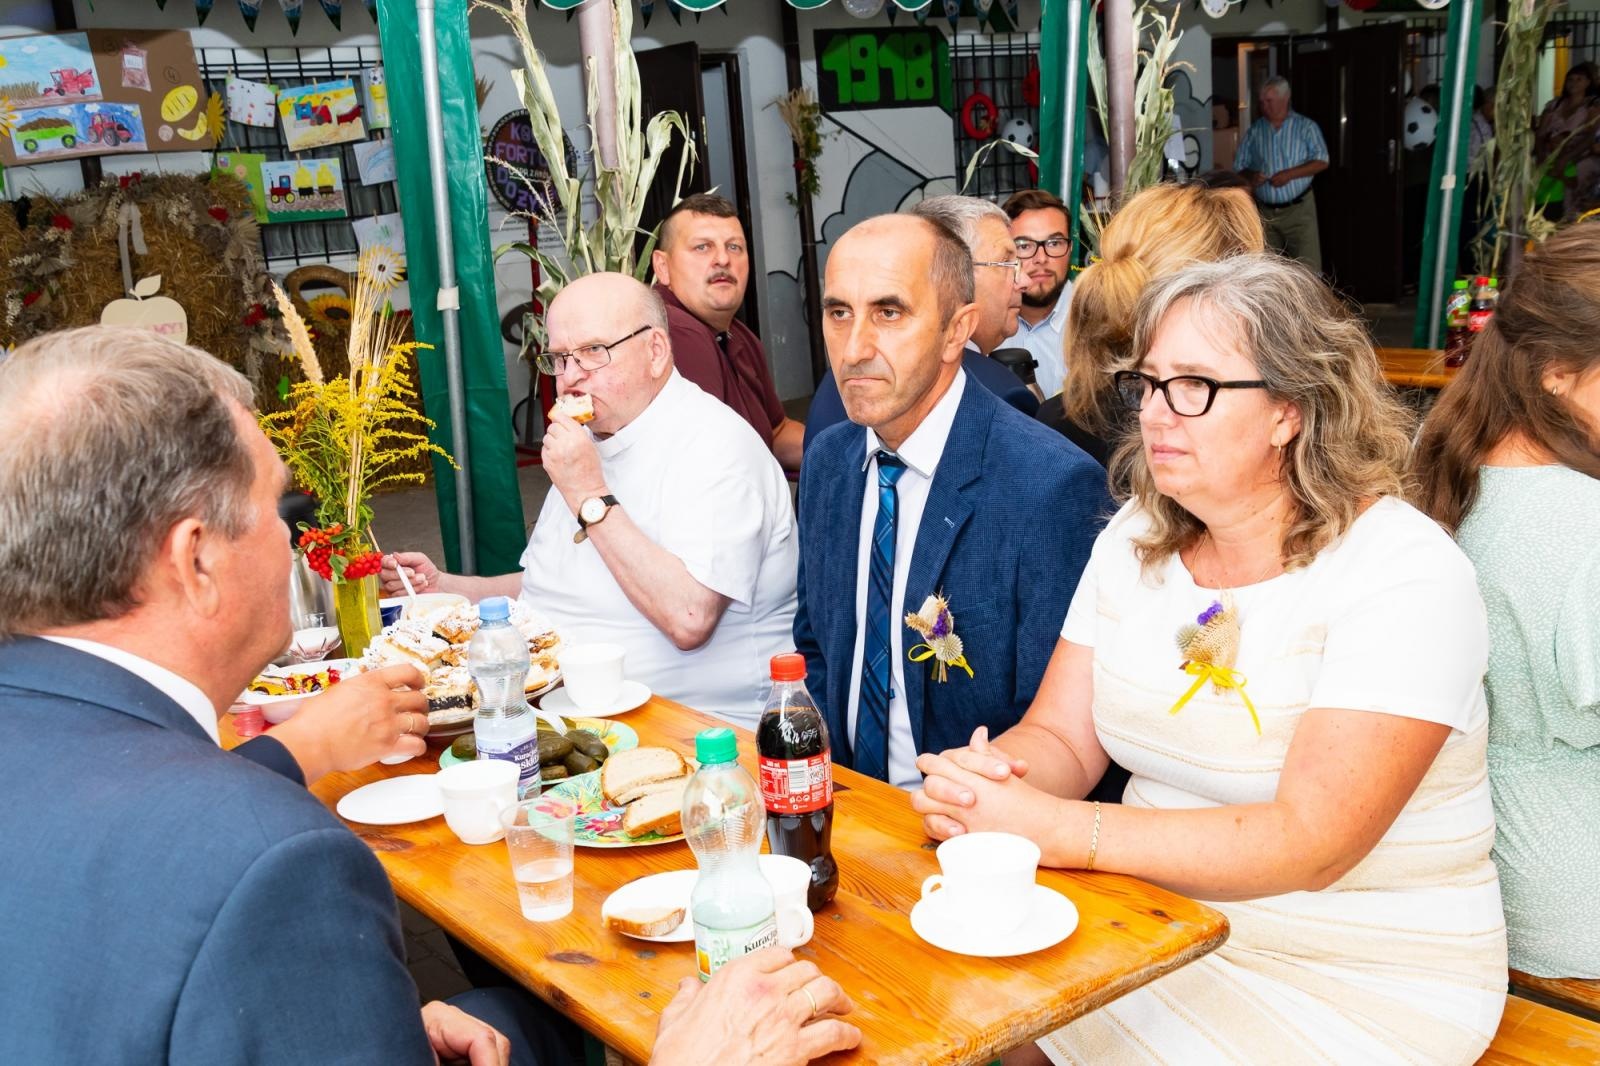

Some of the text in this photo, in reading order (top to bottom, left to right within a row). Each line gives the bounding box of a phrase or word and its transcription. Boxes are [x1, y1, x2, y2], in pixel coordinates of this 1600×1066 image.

[822, 33, 934, 104] 1918
[511, 122, 533, 142] KO
[496, 142, 548, 166] FORTU
